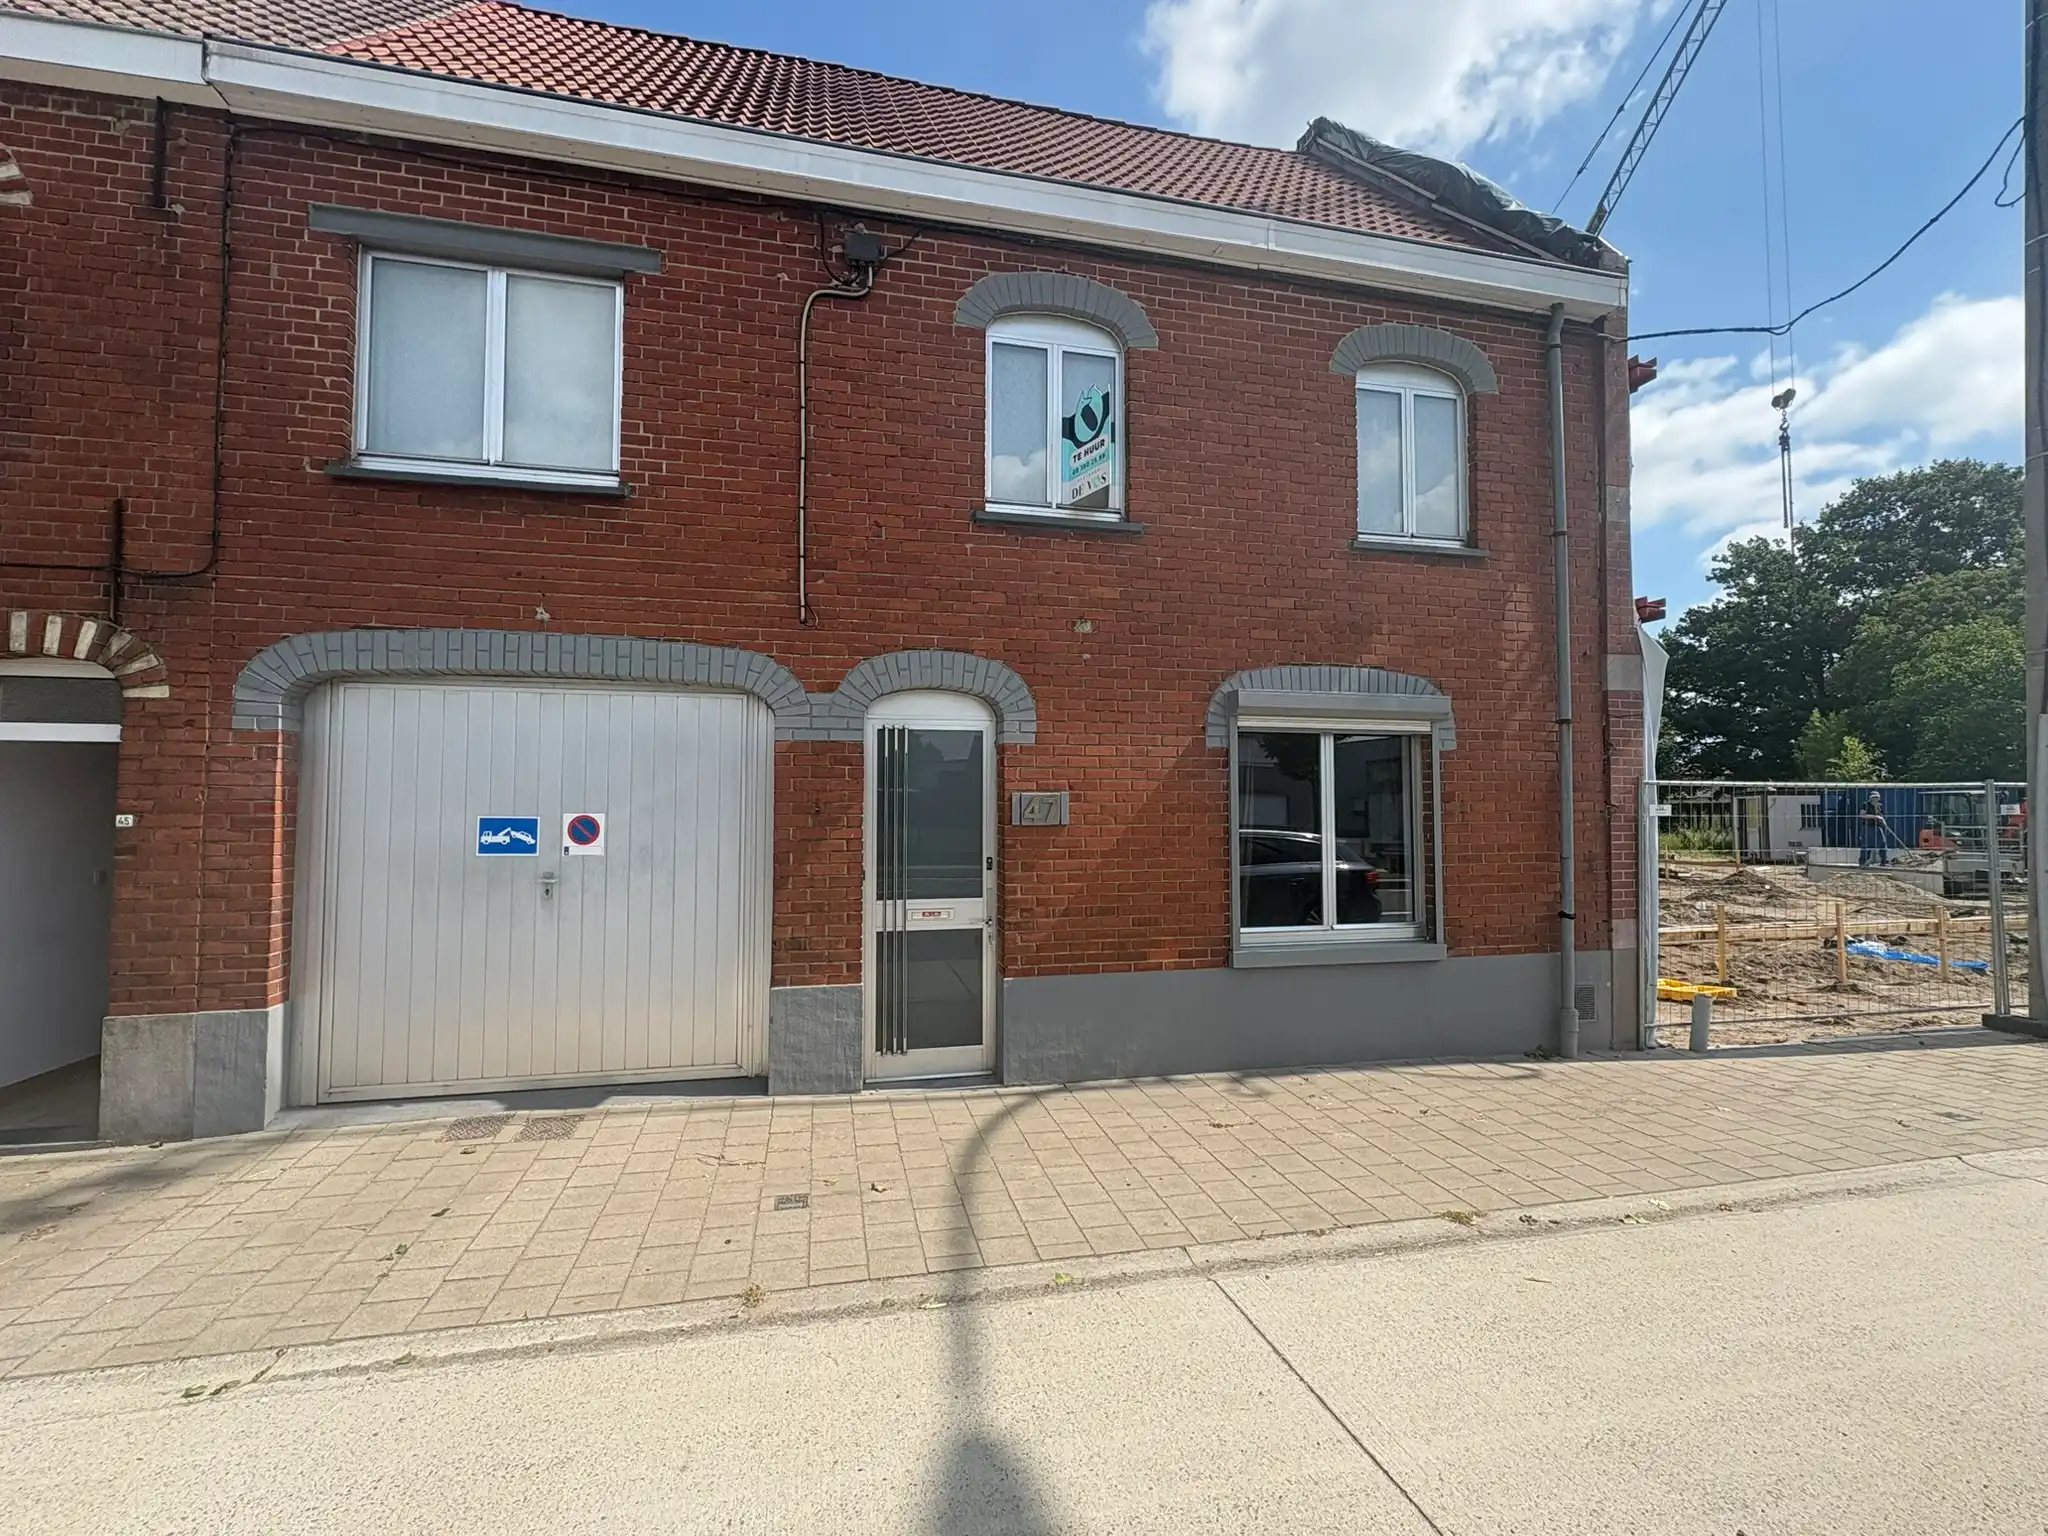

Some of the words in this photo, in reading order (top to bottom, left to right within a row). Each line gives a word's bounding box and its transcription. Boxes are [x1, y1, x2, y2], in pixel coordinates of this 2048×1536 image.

[1073, 452, 1082, 463] TE
[1084, 439, 1105, 457] HUUR
[1072, 483, 1084, 499] DE
[1087, 472, 1107, 490] VOS
[118, 816, 131, 826] 45
[1023, 795, 1057, 823] 47
